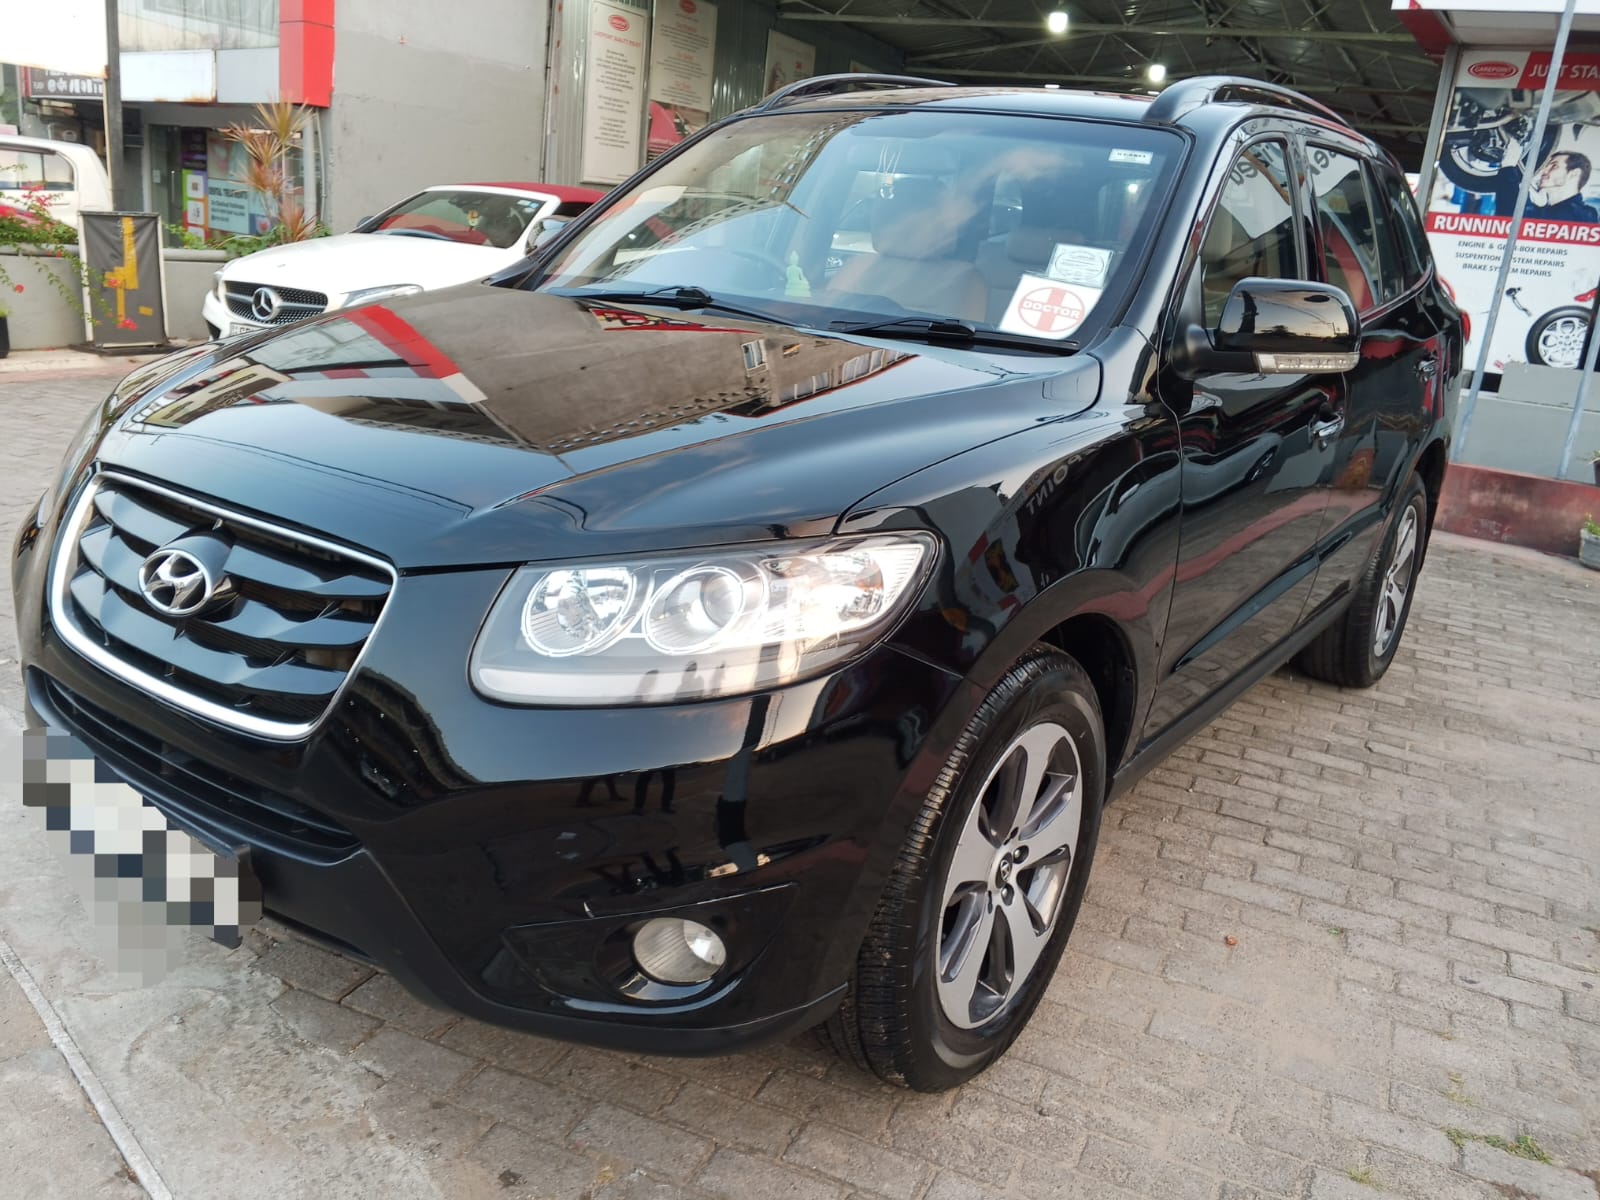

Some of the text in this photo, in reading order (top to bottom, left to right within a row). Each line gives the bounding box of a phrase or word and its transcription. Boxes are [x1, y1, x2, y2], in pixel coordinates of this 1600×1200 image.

[1528, 64, 1600, 79] JUT STA
[1522, 222, 1600, 243] REPAIRS
[1458, 240, 1486, 249] ENGINE
[1537, 246, 1568, 256] REPAIRS
[1456, 252, 1565, 268] SUSPENTION STEM REPAIRS
[1462, 263, 1552, 277] BRAKE SYM REPAIRS
[1022, 300, 1081, 319] DOCTOR
